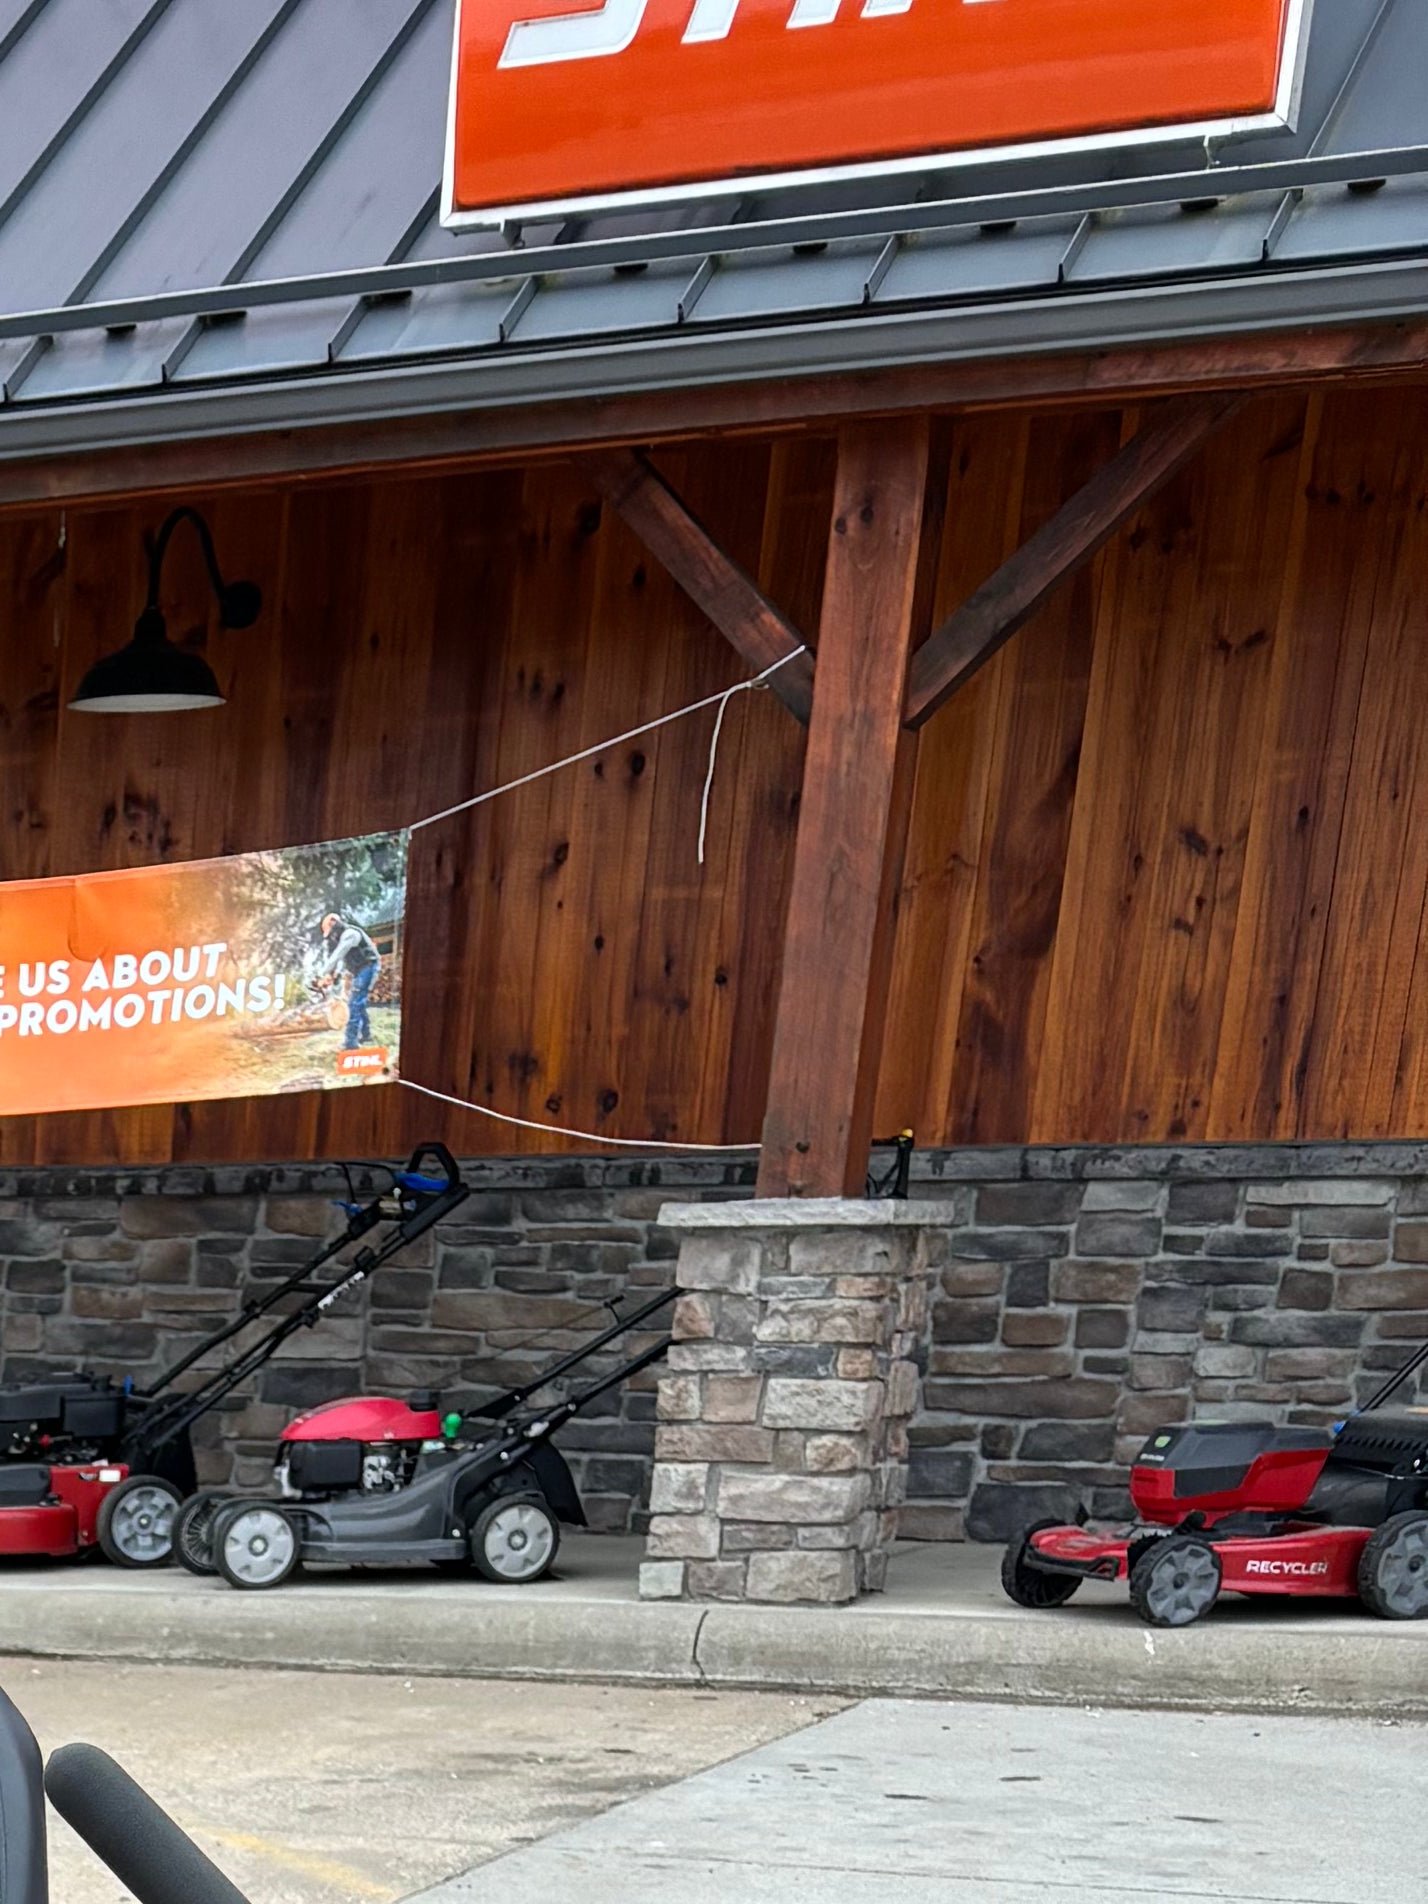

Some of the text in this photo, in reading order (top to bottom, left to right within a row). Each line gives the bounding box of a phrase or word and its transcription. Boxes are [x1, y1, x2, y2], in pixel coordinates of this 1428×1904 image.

[18, 957, 70, 996] US
[82, 942, 227, 990] ABOUT
[1246, 1559, 1328, 1574] RECYCLER
